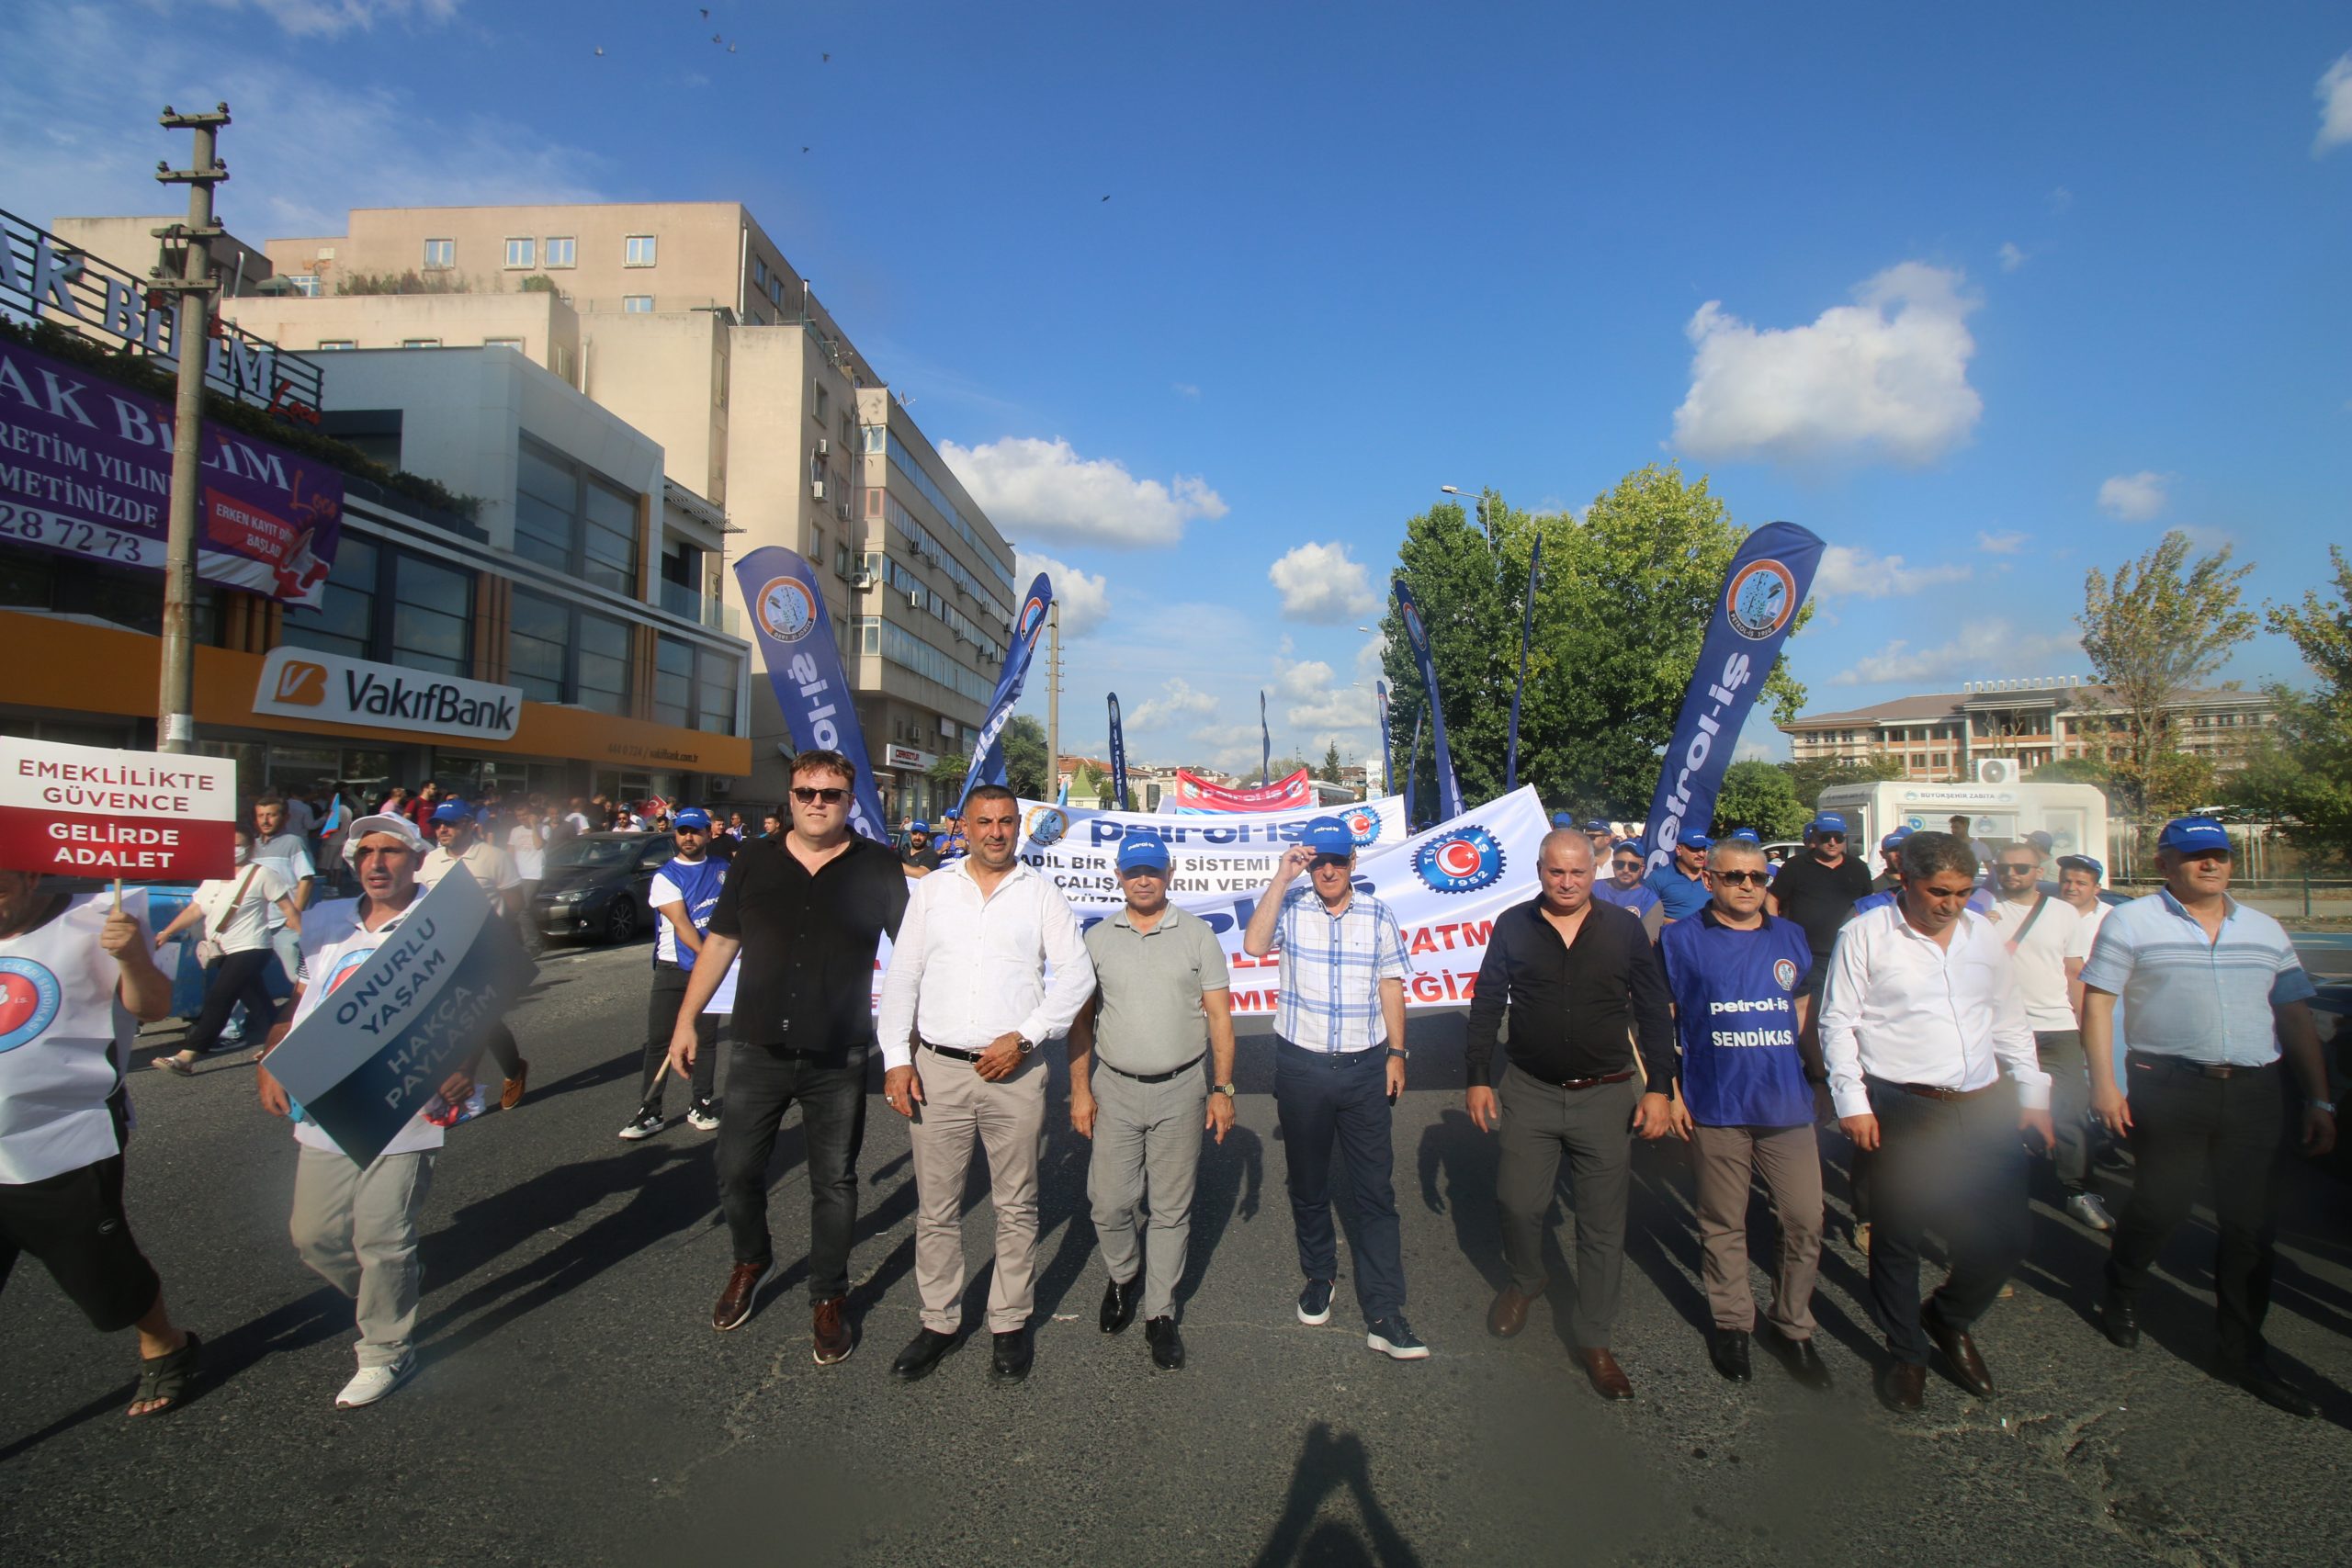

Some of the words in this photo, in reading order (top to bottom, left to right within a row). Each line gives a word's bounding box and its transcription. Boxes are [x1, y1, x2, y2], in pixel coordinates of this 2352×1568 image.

[216, 503, 249, 526] ERKEN
[252, 516, 278, 537] KAYIT
[55, 517, 94, 551] 72
[105, 531, 141, 562] 73
[346, 670, 514, 730] VakıfBank
[18, 759, 214, 791] EMEKLİLİKTE
[42, 785, 189, 812] GÜVENCE
[49, 822, 179, 846] GELİRDE
[1425, 835, 1457, 864] TÜRK
[1474, 837, 1489, 853] İŞ
[53, 847, 175, 868] ADALET
[1071, 855, 1106, 870] BİR
[1185, 855, 1271, 872] SİSTEMİ
[1447, 871, 1488, 886] 1952
[336, 918, 436, 1024] ONURLU
[360, 949, 446, 1035] YAŞAM
[1710, 998, 1790, 1015] petrol-iş
[387, 986, 472, 1075] HAKÇA
[385, 984, 497, 1110] PAYLAŞIM
